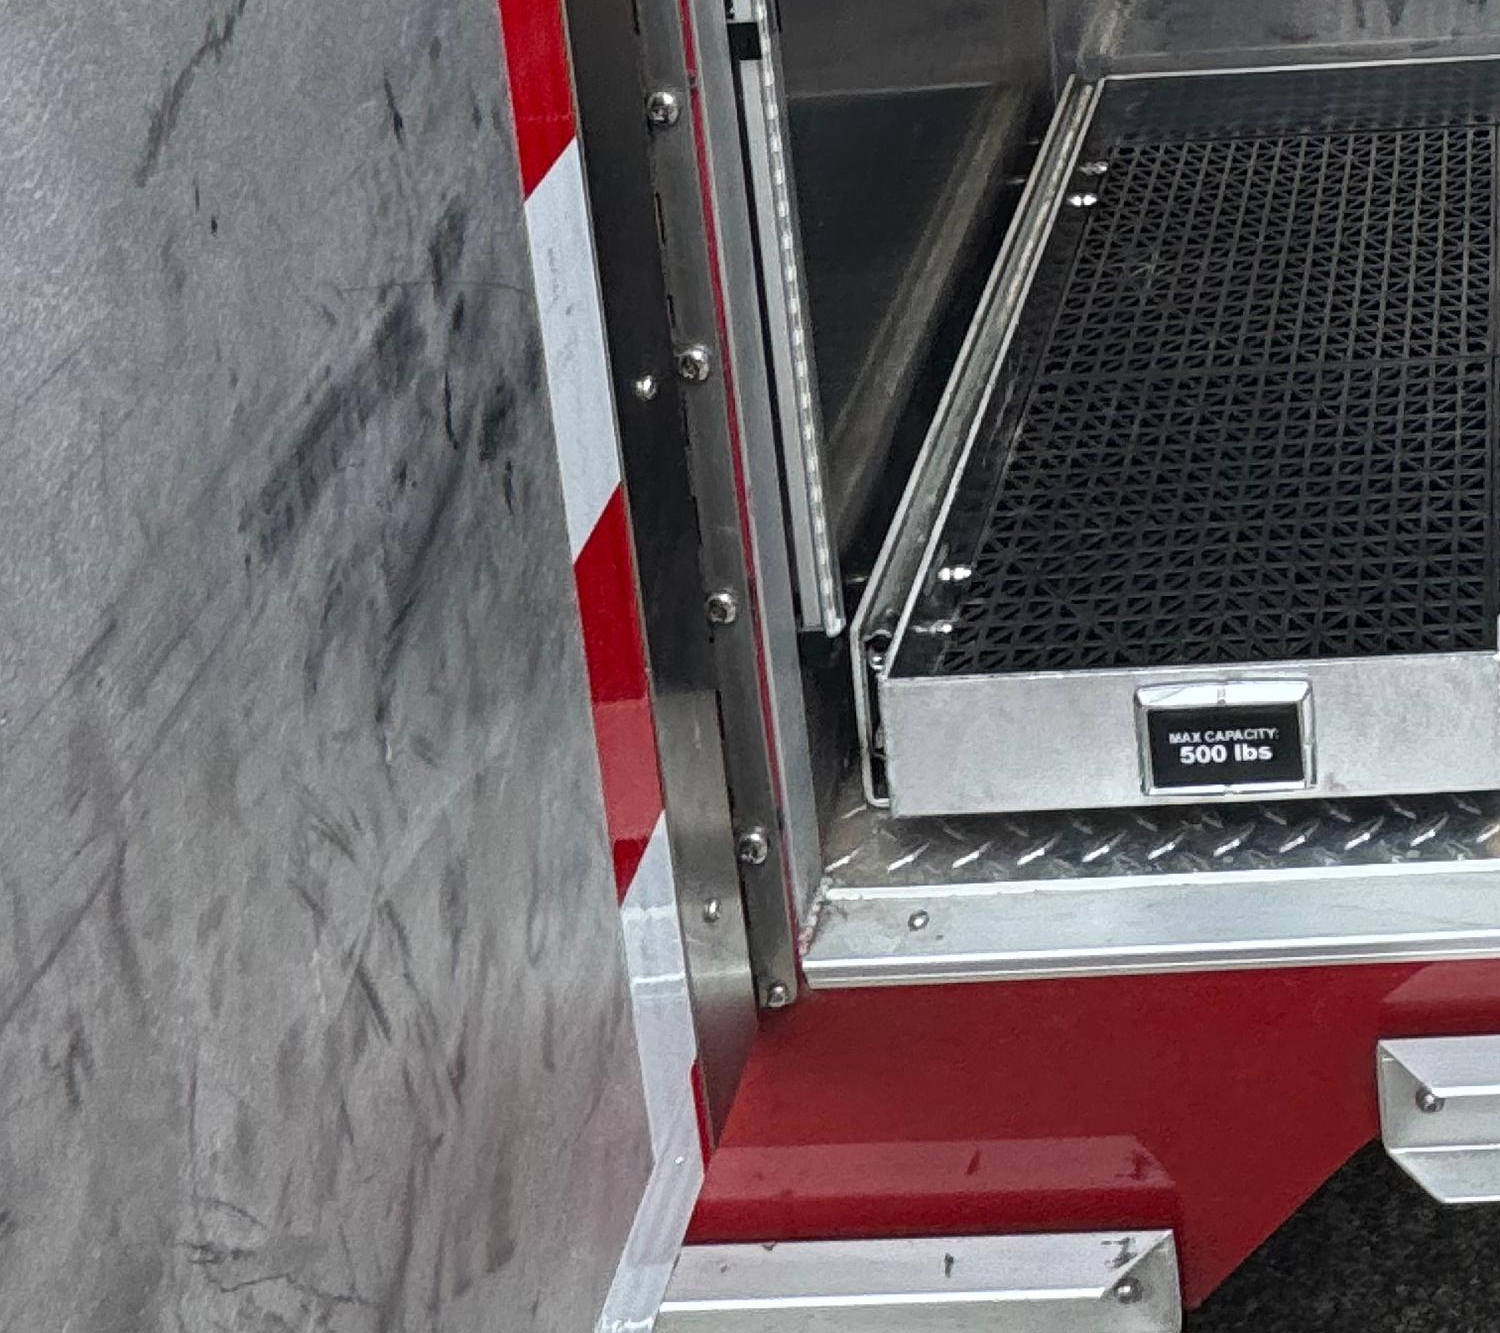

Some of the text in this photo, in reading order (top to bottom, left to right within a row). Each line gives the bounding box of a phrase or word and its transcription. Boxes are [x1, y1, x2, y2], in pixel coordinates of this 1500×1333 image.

[1168, 731, 1201, 744] MAX
[1180, 743, 1273, 764] 500 lbs
